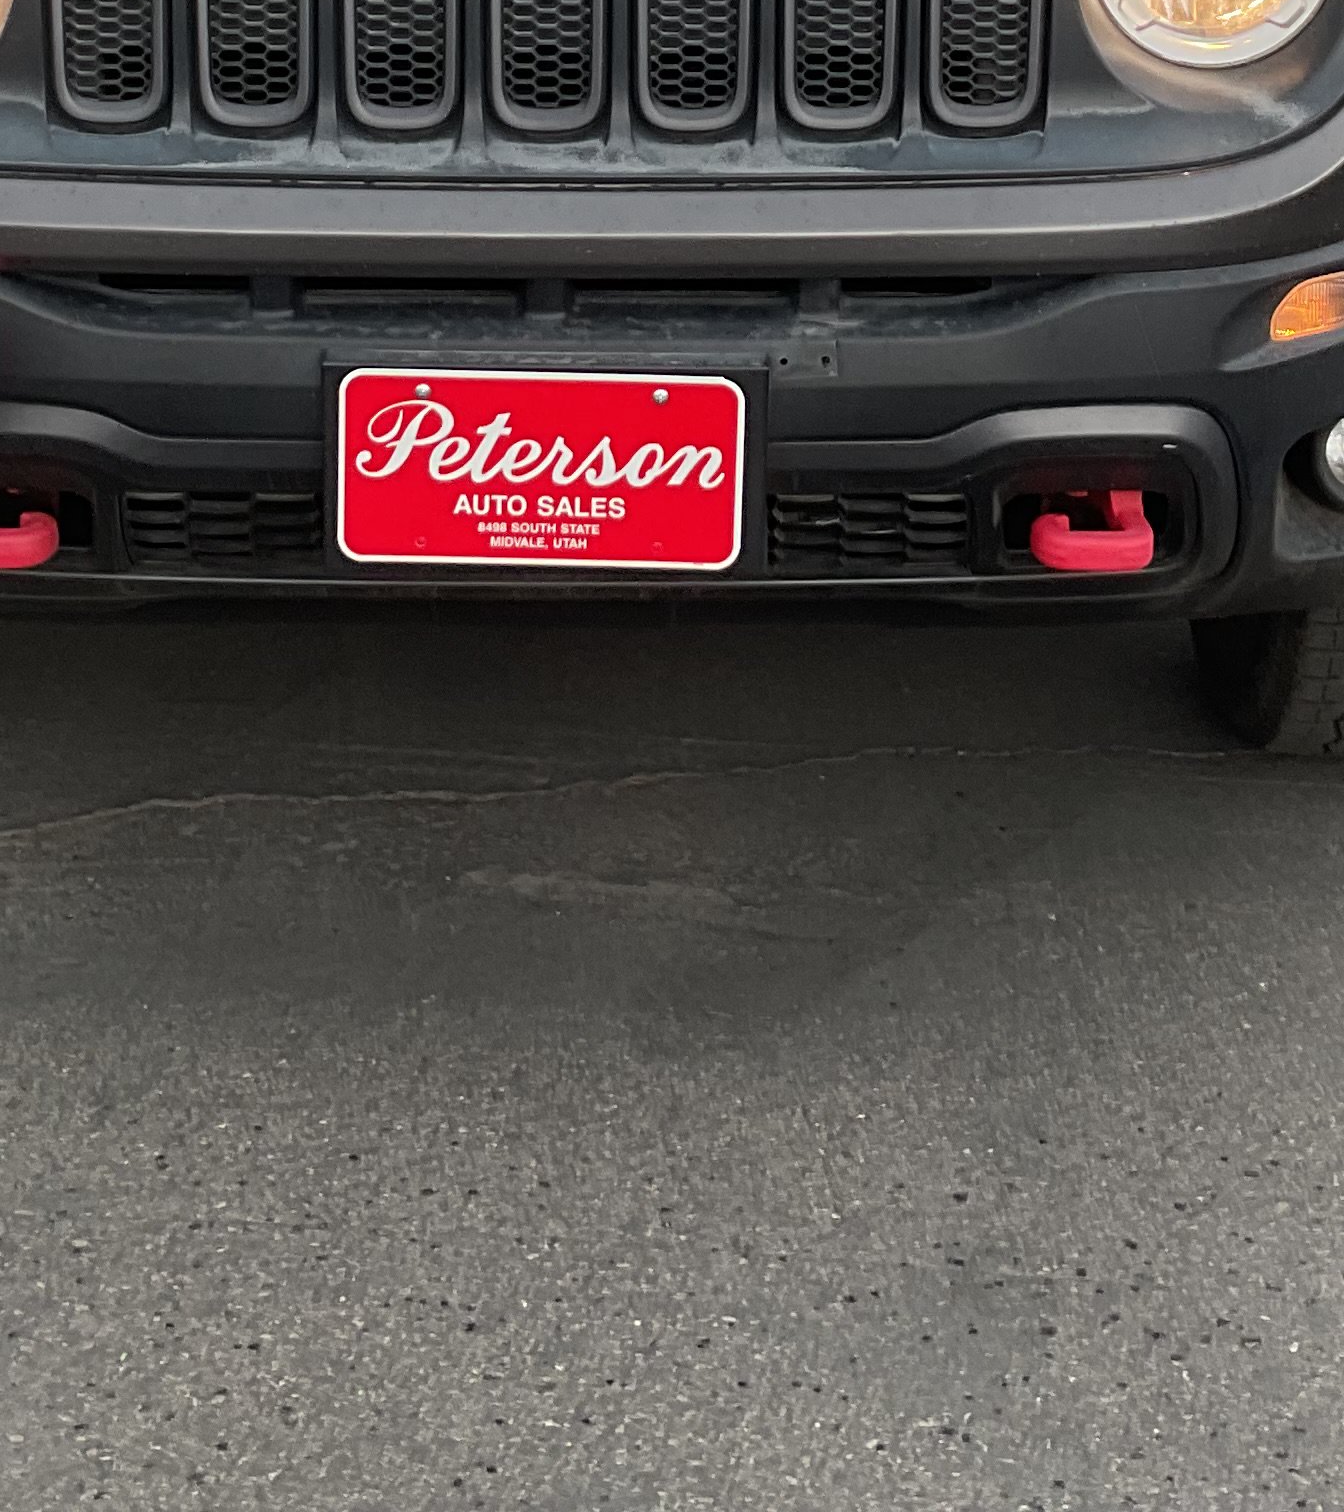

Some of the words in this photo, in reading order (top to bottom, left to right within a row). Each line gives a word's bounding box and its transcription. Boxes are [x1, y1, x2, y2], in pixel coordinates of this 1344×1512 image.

[355, 399, 726, 490] Peterson
[453, 493, 528, 517] AUTO
[536, 495, 626, 519] SALES
[477, 521, 508, 534] 8498
[511, 522, 556, 534] SOUTH
[560, 523, 600, 536] STATE
[489, 536, 549, 550] MIDVALE,
[553, 537, 588, 550] UTAH
